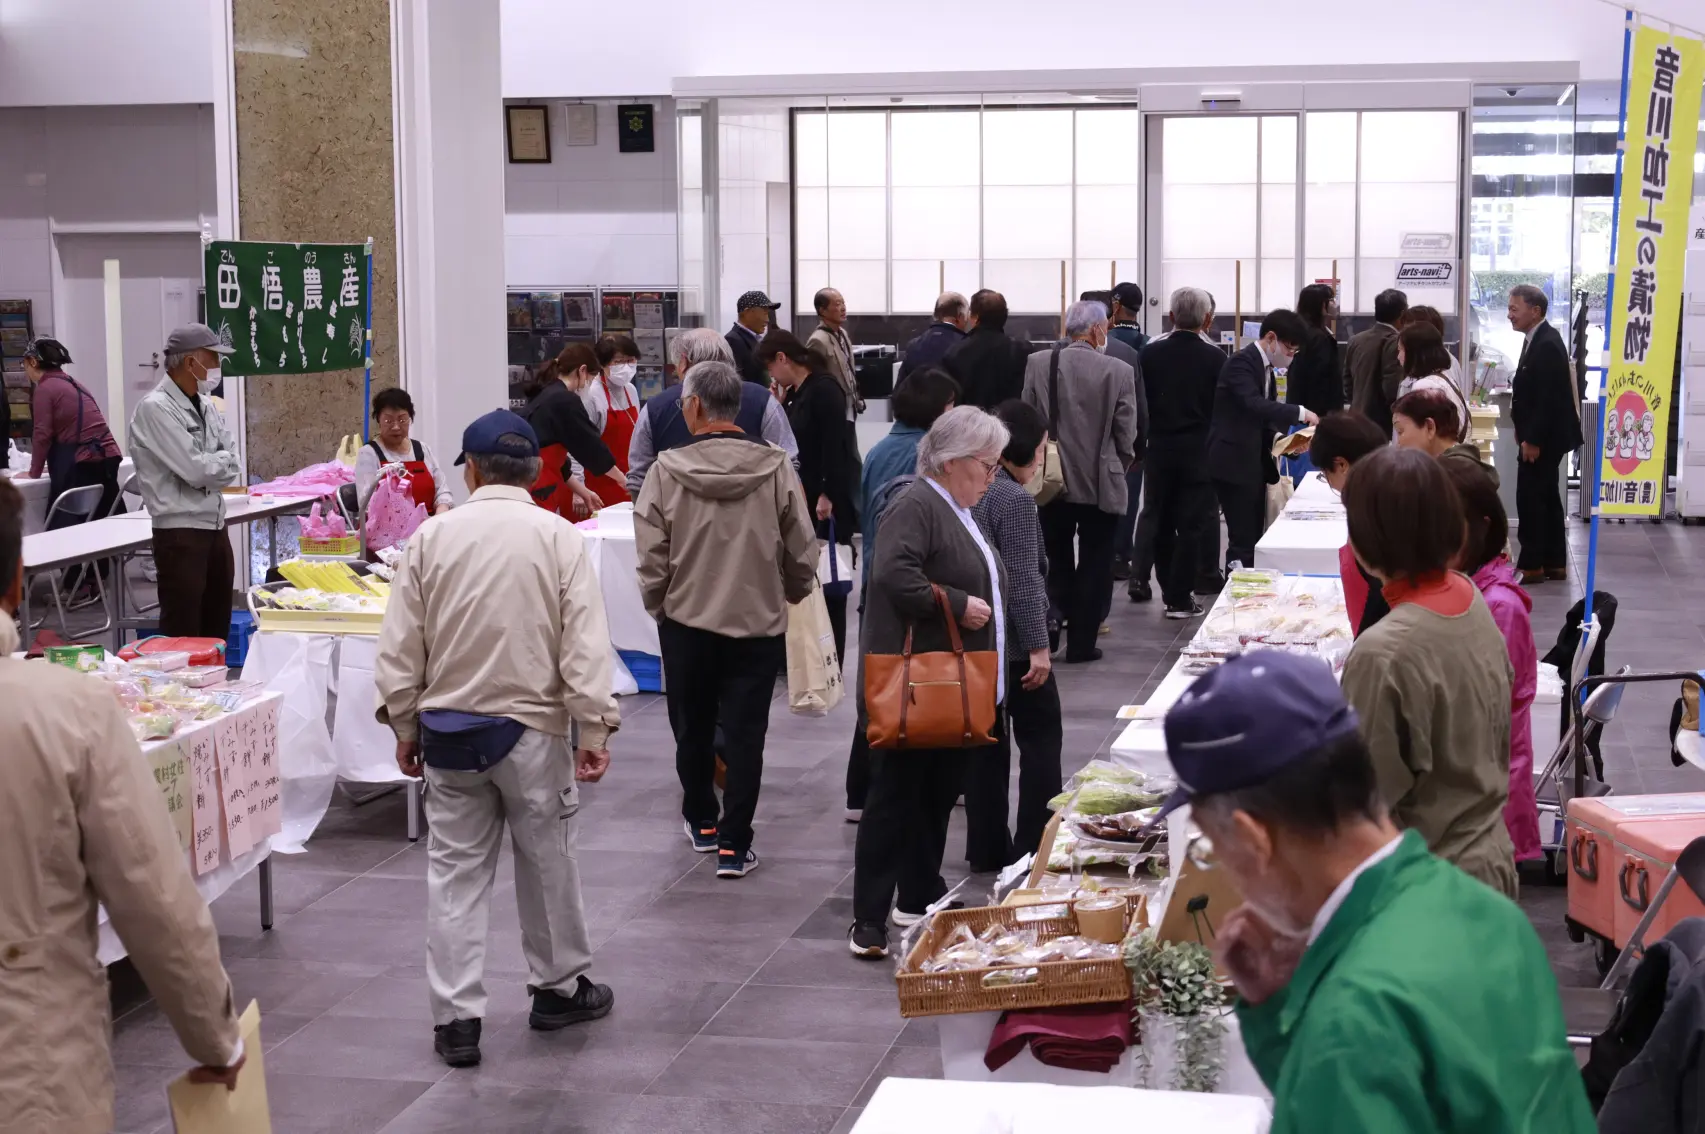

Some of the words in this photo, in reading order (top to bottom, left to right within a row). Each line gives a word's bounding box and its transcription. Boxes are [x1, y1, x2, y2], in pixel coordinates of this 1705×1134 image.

[220, 249, 236, 264] でん
[267, 251, 275, 264] ご
[304, 251, 317, 264] のう
[343, 252, 357, 265] さん
[1401, 267, 1440, 276] arts-navi
[217, 263, 360, 311] 田悟農産
